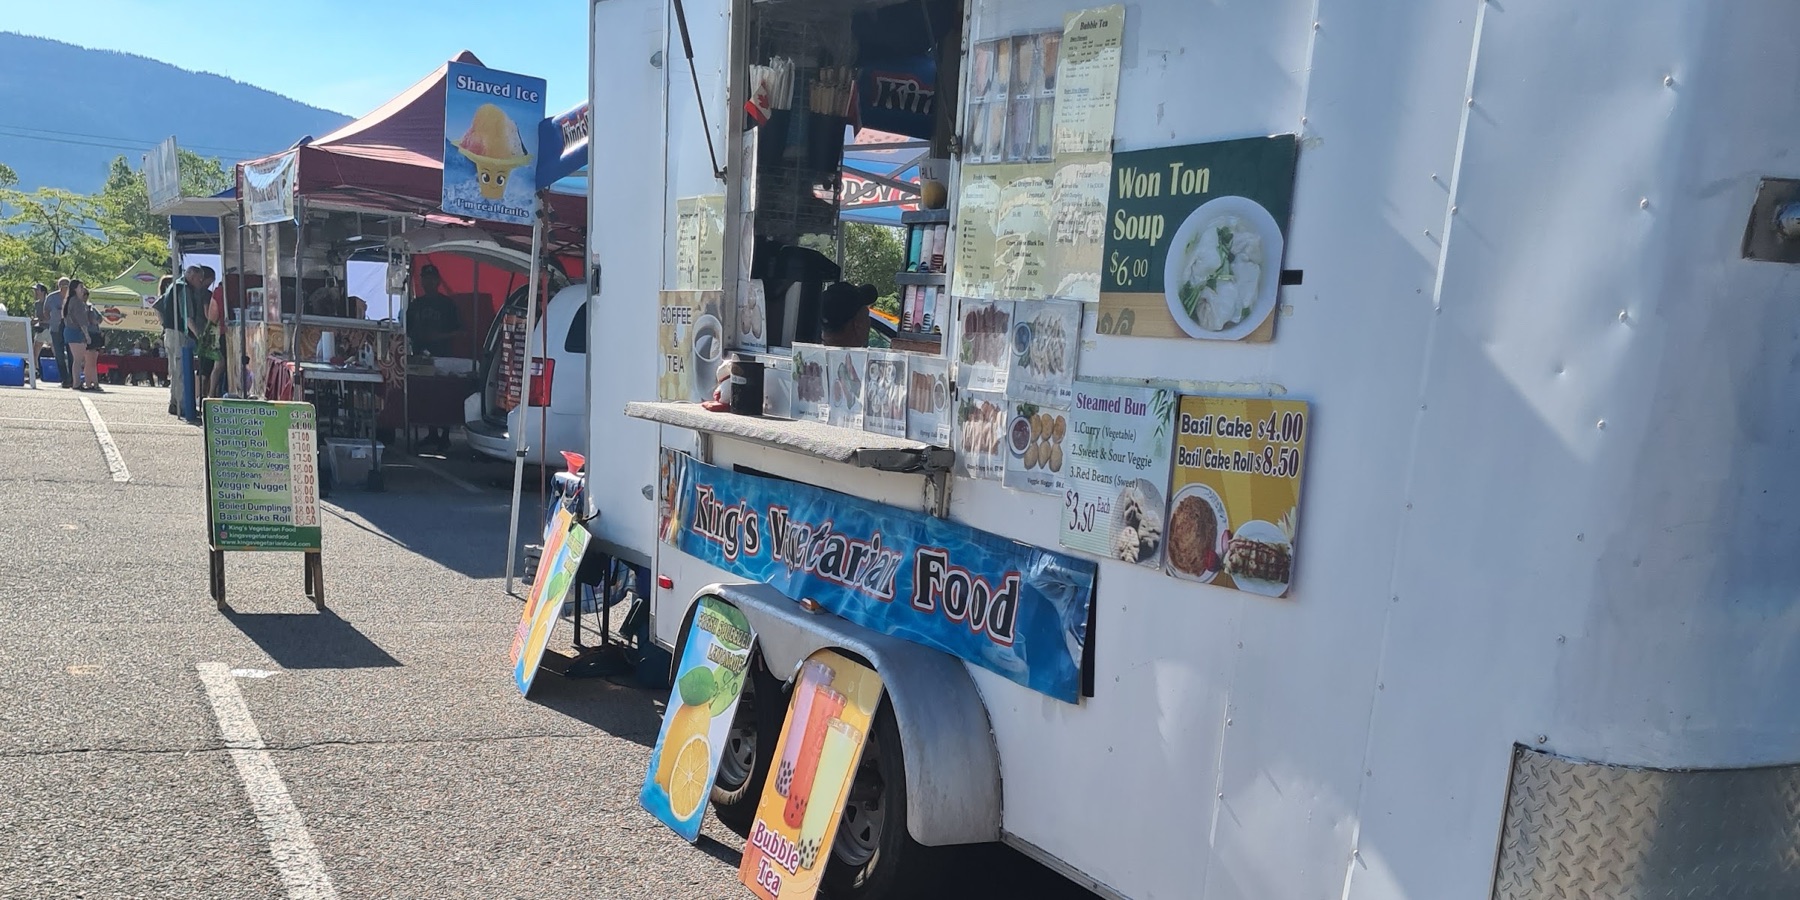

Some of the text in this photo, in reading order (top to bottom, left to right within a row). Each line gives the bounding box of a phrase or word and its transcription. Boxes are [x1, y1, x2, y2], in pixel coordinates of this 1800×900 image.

[1080, 19, 1109, 30] Bubble Tea
[456, 75, 539, 102] Shaved Ice
[872, 77, 935, 115] Kin
[1118, 162, 1210, 199] Won Ton
[456, 198, 530, 218] I'm real fruits
[1113, 208, 1165, 247] Soup
[1109, 249, 1148, 286] $6.00
[661, 307, 692, 325] COFFEE
[673, 333, 679, 348] &
[667, 355, 685, 373] TEA
[212, 405, 257, 415] Steamed
[259, 408, 278, 416] Bun
[1076, 393, 1147, 416] Steamed Bun
[213, 416, 239, 424] Basil
[240, 417, 265, 426] Cake
[1180, 410, 1304, 444] Basil Cake $4.00
[214, 427, 243, 436] Salad
[244, 428, 263, 436] Roll
[1074, 421, 1137, 443] 1.Curry (Vegetable)
[214, 438, 247, 448] Spring
[250, 439, 268, 447] Roll
[215, 448, 239, 458] Honey
[240, 449, 264, 460] Crispy
[266, 451, 289, 459] Beans
[1072, 444, 1152, 470] 2.Sweet & Sour Veggie
[1178, 445, 1300, 478] Basil Cake Roll $8.50
[215, 460, 239, 468] Sweet
[247, 461, 264, 469] Sour
[266, 462, 290, 471] Veggie
[216, 470, 239, 480] Crispy
[240, 471, 262, 479] Beans
[217, 481, 250, 491] Veggie
[253, 482, 288, 492] Nugget
[1069, 466, 1139, 488] 3.Red Beans (Sweet)
[218, 491, 245, 499] Sushi
[218, 502, 246, 510] Boiled
[247, 503, 292, 513] Dumplings
[219, 513, 243, 521] Basil
[273, 514, 291, 522] Roll
[1065, 488, 1111, 532] $3.50 Each
[692, 484, 760, 560] King's
[912, 547, 1022, 647] Food
[752, 819, 801, 876] Bubble
[756, 857, 781, 898] Tea
